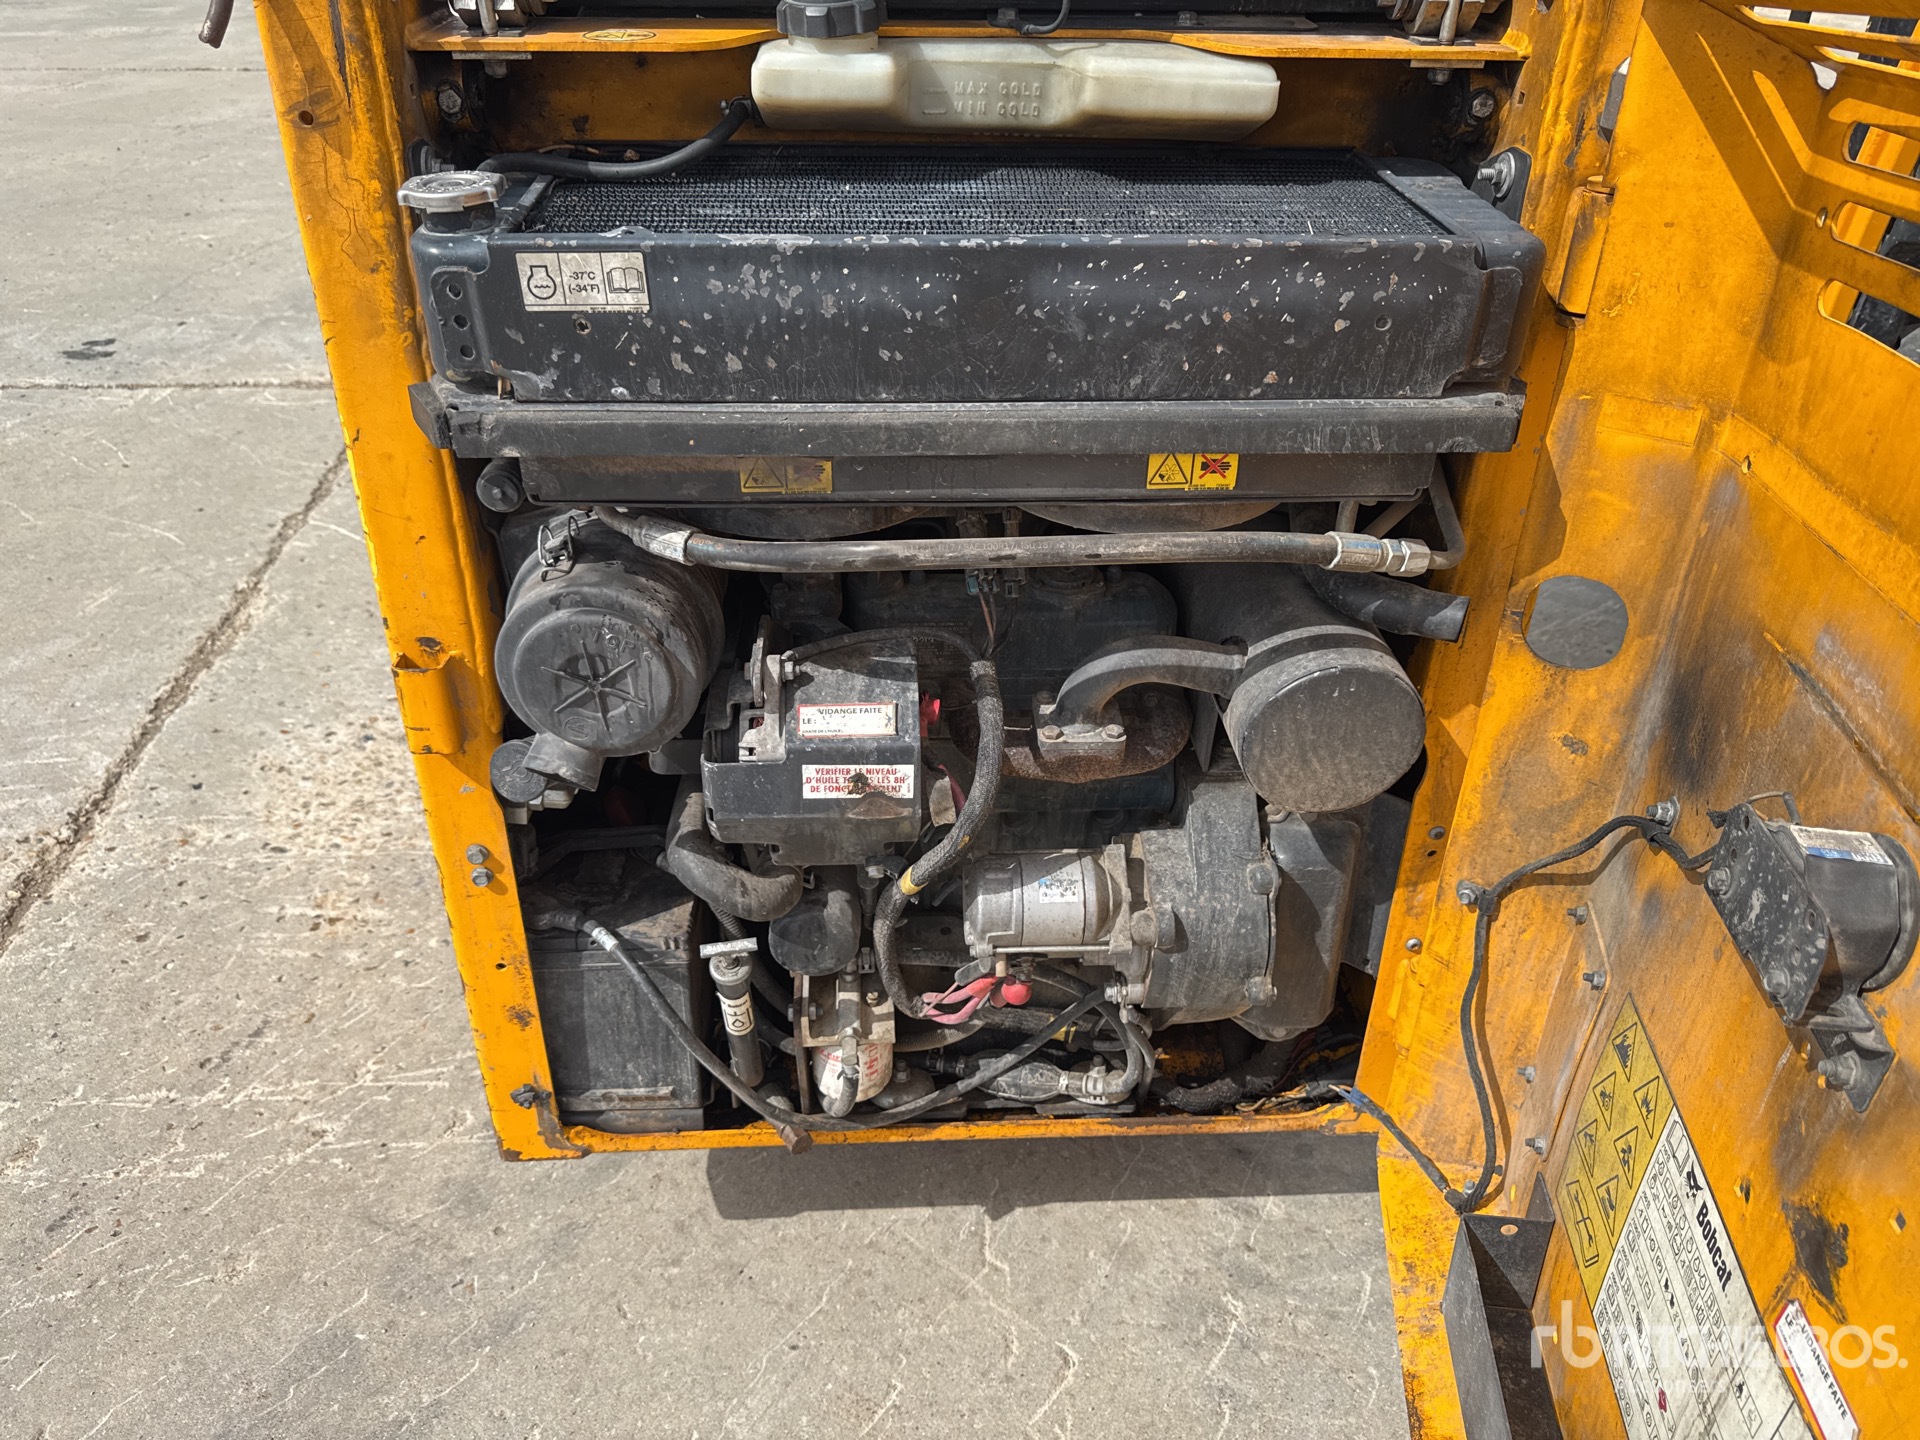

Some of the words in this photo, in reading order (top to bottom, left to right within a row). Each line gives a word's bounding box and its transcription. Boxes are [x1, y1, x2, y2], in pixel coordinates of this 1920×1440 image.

[955, 81, 988, 95] MAX
[953, 101, 986, 115] MIN
[1696, 1200, 1732, 1293] Bobcat
[1828, 1382, 1848, 1420] FAITE
